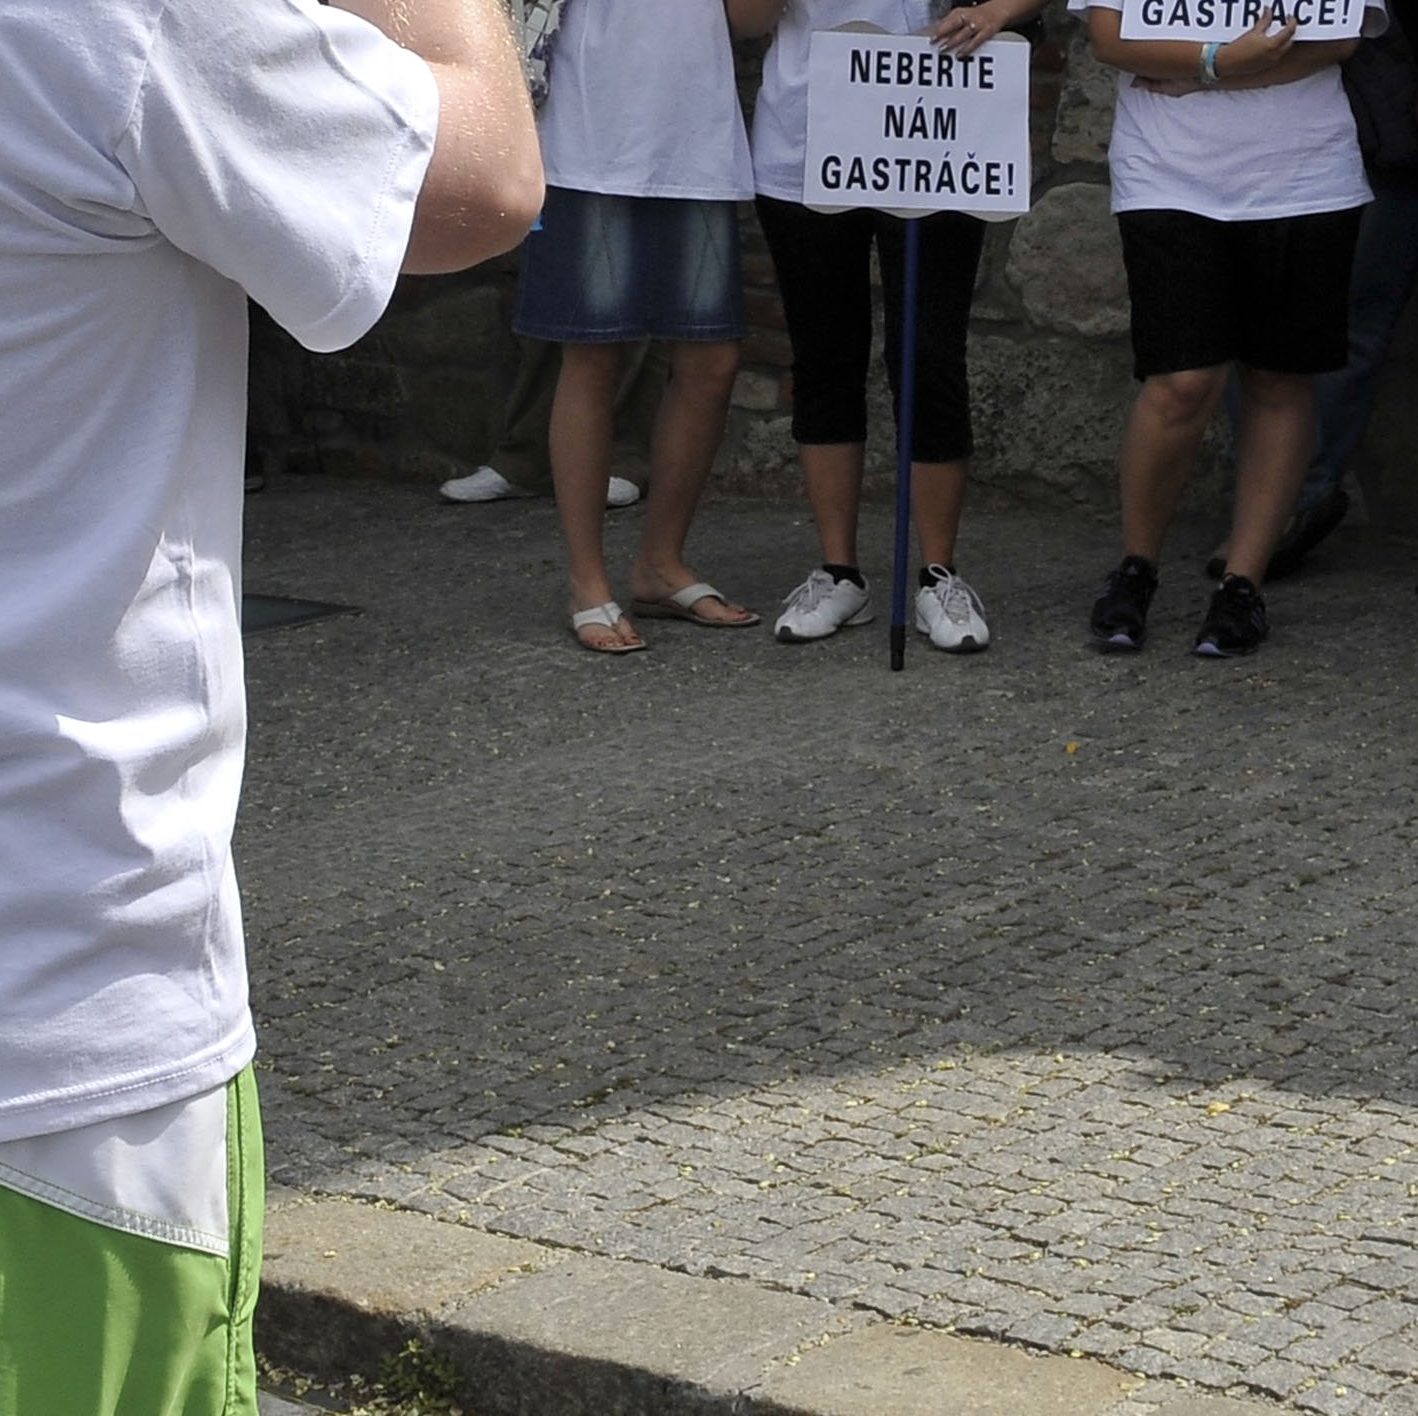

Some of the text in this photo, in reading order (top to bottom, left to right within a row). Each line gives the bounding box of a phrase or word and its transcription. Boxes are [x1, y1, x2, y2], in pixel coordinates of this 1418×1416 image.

[850, 50, 994, 90] NEBERTE
[884, 98, 957, 141] NÁM
[821, 151, 1015, 196] GASTRÁČE!
